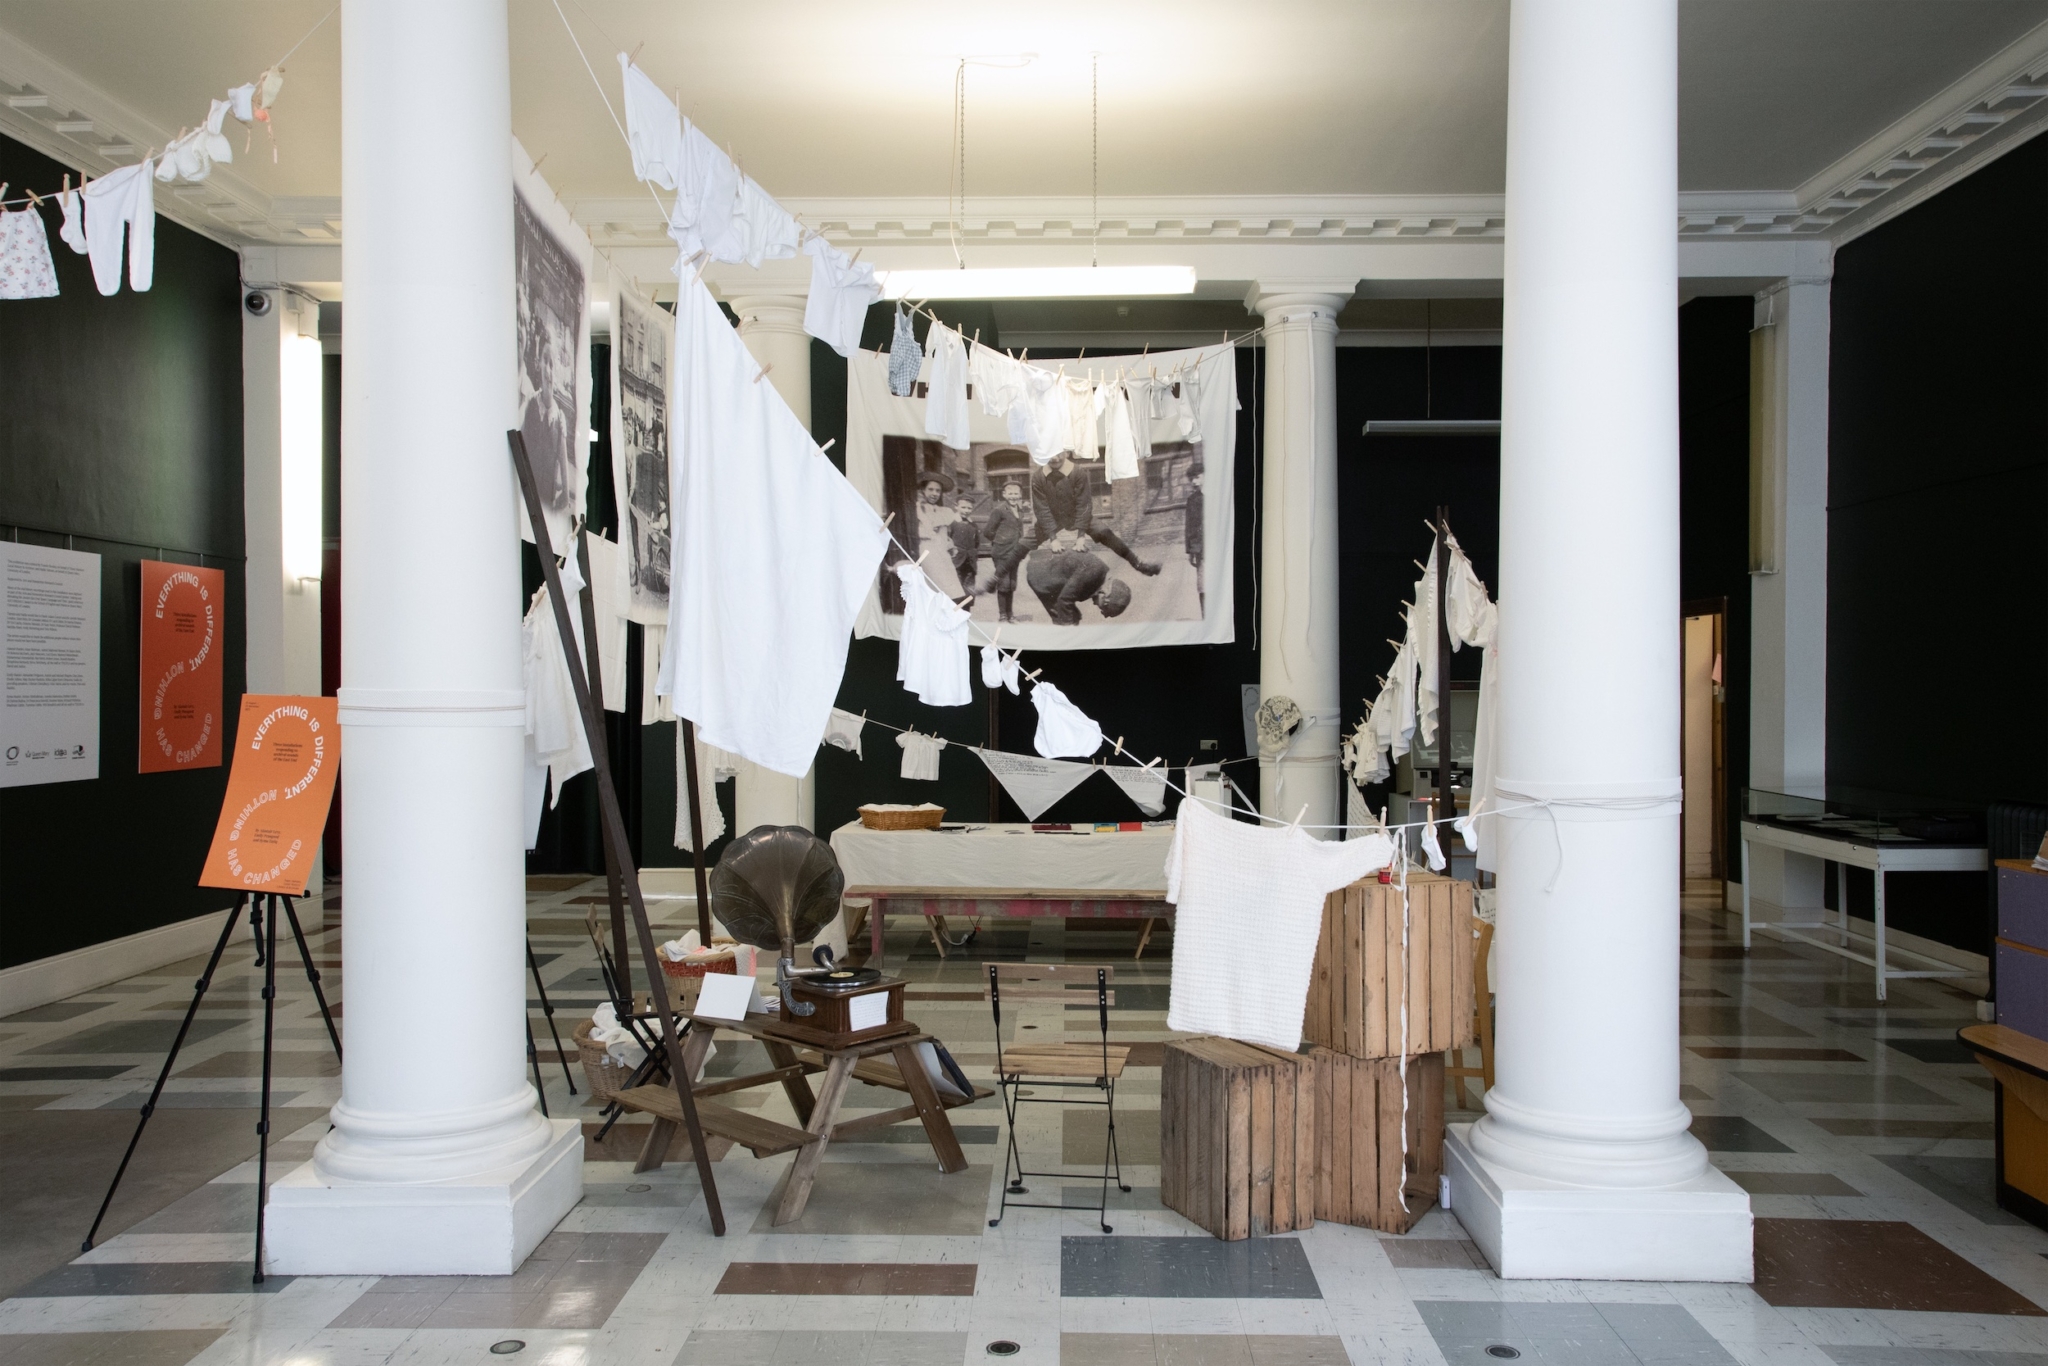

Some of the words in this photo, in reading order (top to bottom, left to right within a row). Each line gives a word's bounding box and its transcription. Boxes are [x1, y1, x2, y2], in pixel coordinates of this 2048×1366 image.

[155, 571, 199, 619] EVERYTHING
[199, 585, 209, 601] IS
[154, 660, 185, 720] NOTHING
[156, 727, 173, 757] HAS
[176, 713, 212, 764] CHANGED
[251, 705, 309, 751] EVERYTHING
[309, 718, 320, 733] IS
[284, 735, 324, 800] DIFFERENT,
[229, 788, 278, 842] NOTHING
[227, 848, 243, 877] HAS
[243, 838, 303, 885] CHANGED
